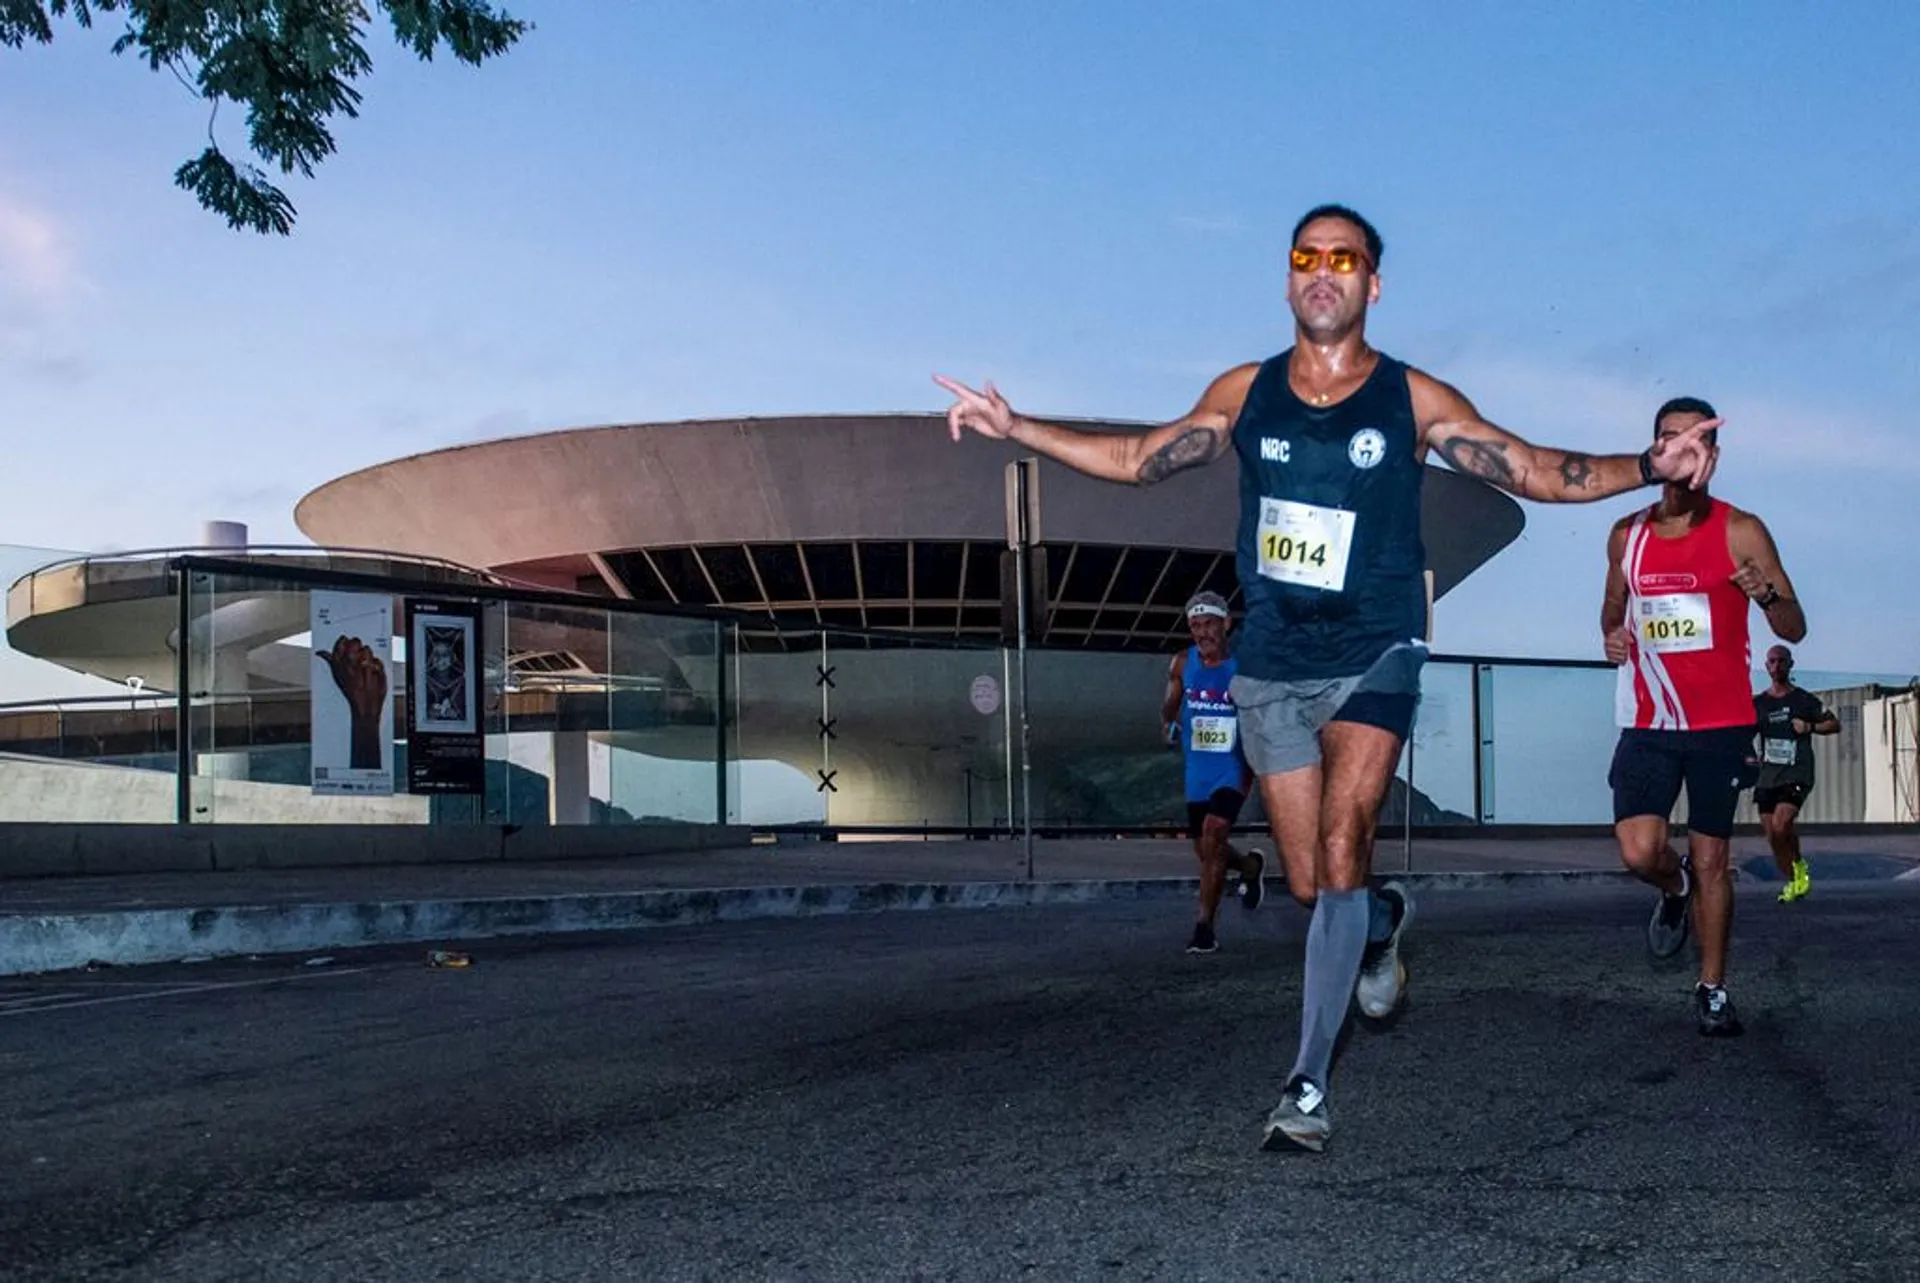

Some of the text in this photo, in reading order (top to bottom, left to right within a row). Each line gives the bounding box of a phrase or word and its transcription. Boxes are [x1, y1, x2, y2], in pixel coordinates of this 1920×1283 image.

[1260, 437, 1291, 463] NRC
[1266, 534, 1327, 567] 1014
[1647, 619, 1696, 639] 1012
[1197, 731, 1227, 744] 1023
